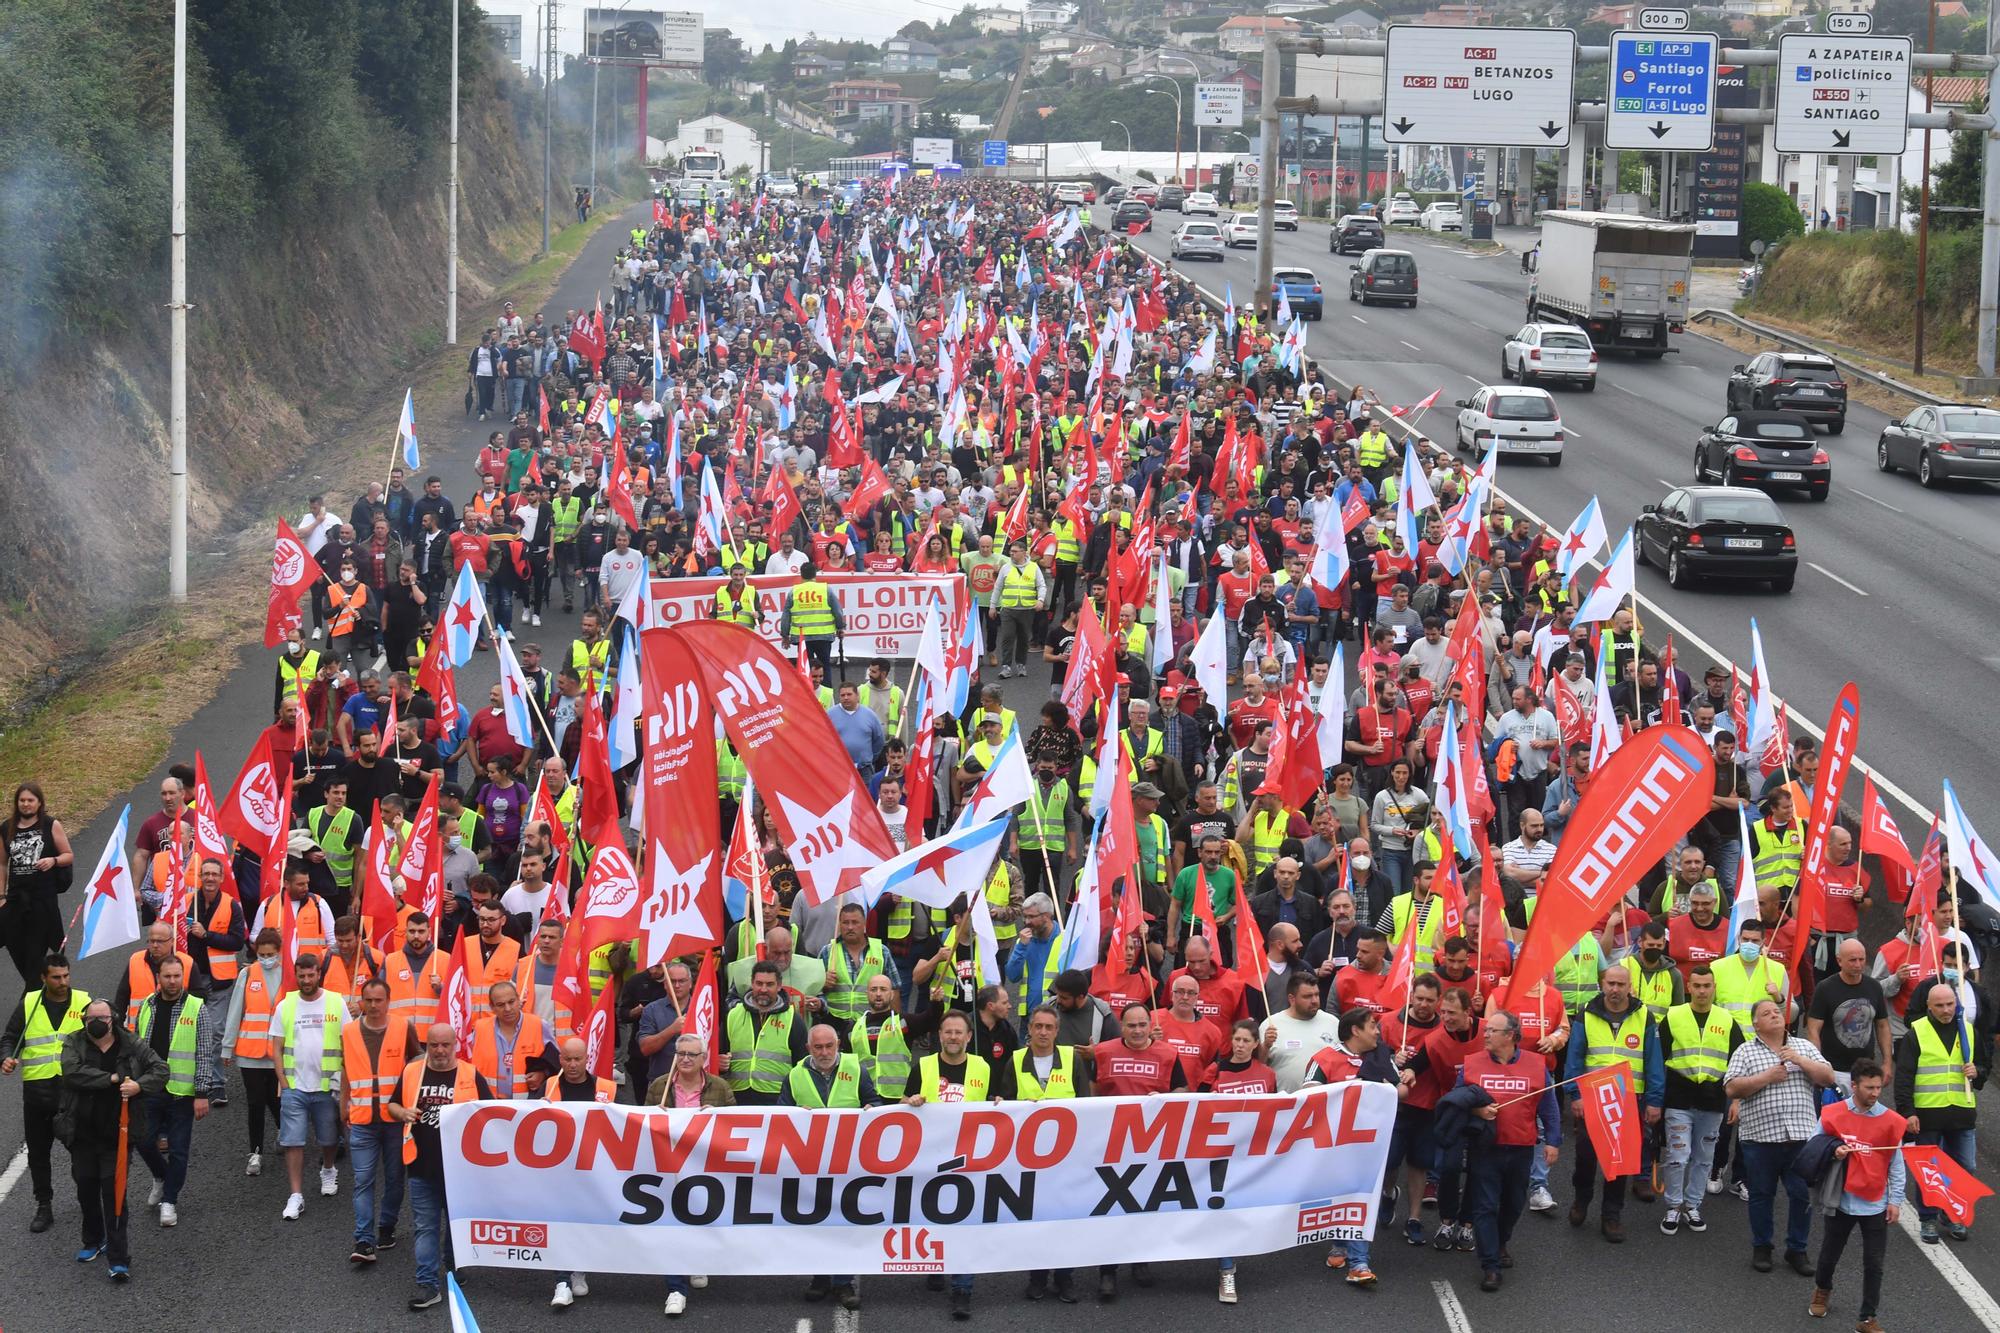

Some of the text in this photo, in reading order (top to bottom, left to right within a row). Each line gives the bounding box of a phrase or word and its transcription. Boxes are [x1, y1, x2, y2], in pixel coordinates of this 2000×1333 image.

[1645, 14, 1669, 24] 300
[1832, 18, 1867, 28] 150 m
[1465, 49, 1496, 60] AC-11
[1637, 44, 1690, 55] E-1 AP-9
[1808, 48, 1904, 62] A ZAPATEIRA
[1474, 66, 1553, 80] BETANZOS
[1639, 62, 1704, 77] Santiago
[1813, 68, 1892, 81] policlínico
[1404, 76, 1468, 89] AC-12 N-VI
[1648, 82, 1692, 95] Ferrol
[1717, 79, 1744, 87] PSOL
[1473, 89, 1513, 101] LUGO
[1814, 89, 1848, 100] N-550
[1618, 100, 1705, 114] E-70 A-6 Lugo
[1803, 107, 1880, 120] SANTIAGO
[974, 568, 995, 580] UGT
[798, 590, 822, 603] CIG
[661, 601, 683, 622] O
[857, 586, 947, 608] LOITA
[875, 636, 900, 649] CIG
[1614, 642, 1636, 650] ECAR
[1567, 753, 1687, 900] CCOO
[993, 879, 1006, 889] CIG
[866, 956, 879, 966] CIG
[180, 1017, 194, 1026] CIG
[770, 1018, 785, 1029] CIG
[1710, 1025, 1725, 1036] CIG
[1113, 1063, 1155, 1075] CCOO
[838, 1071, 852, 1082] CIG
[1051, 1073, 1066, 1084] CIG
[970, 1078, 983, 1089] CIG
[1483, 1080, 1526, 1091] CCOO
[461, 1085, 1378, 1175] CONVENIO DO METAL
[619, 1156, 1230, 1225] SOLUCIÓN XA!
[1302, 1207, 1362, 1228] CCOO
[474, 1223, 522, 1243] UGT
[1296, 1227, 1364, 1245] industria
[883, 1226, 944, 1260] CIG
[507, 1248, 542, 1262] FICA
[884, 1263, 943, 1272] INDUSTRIA
